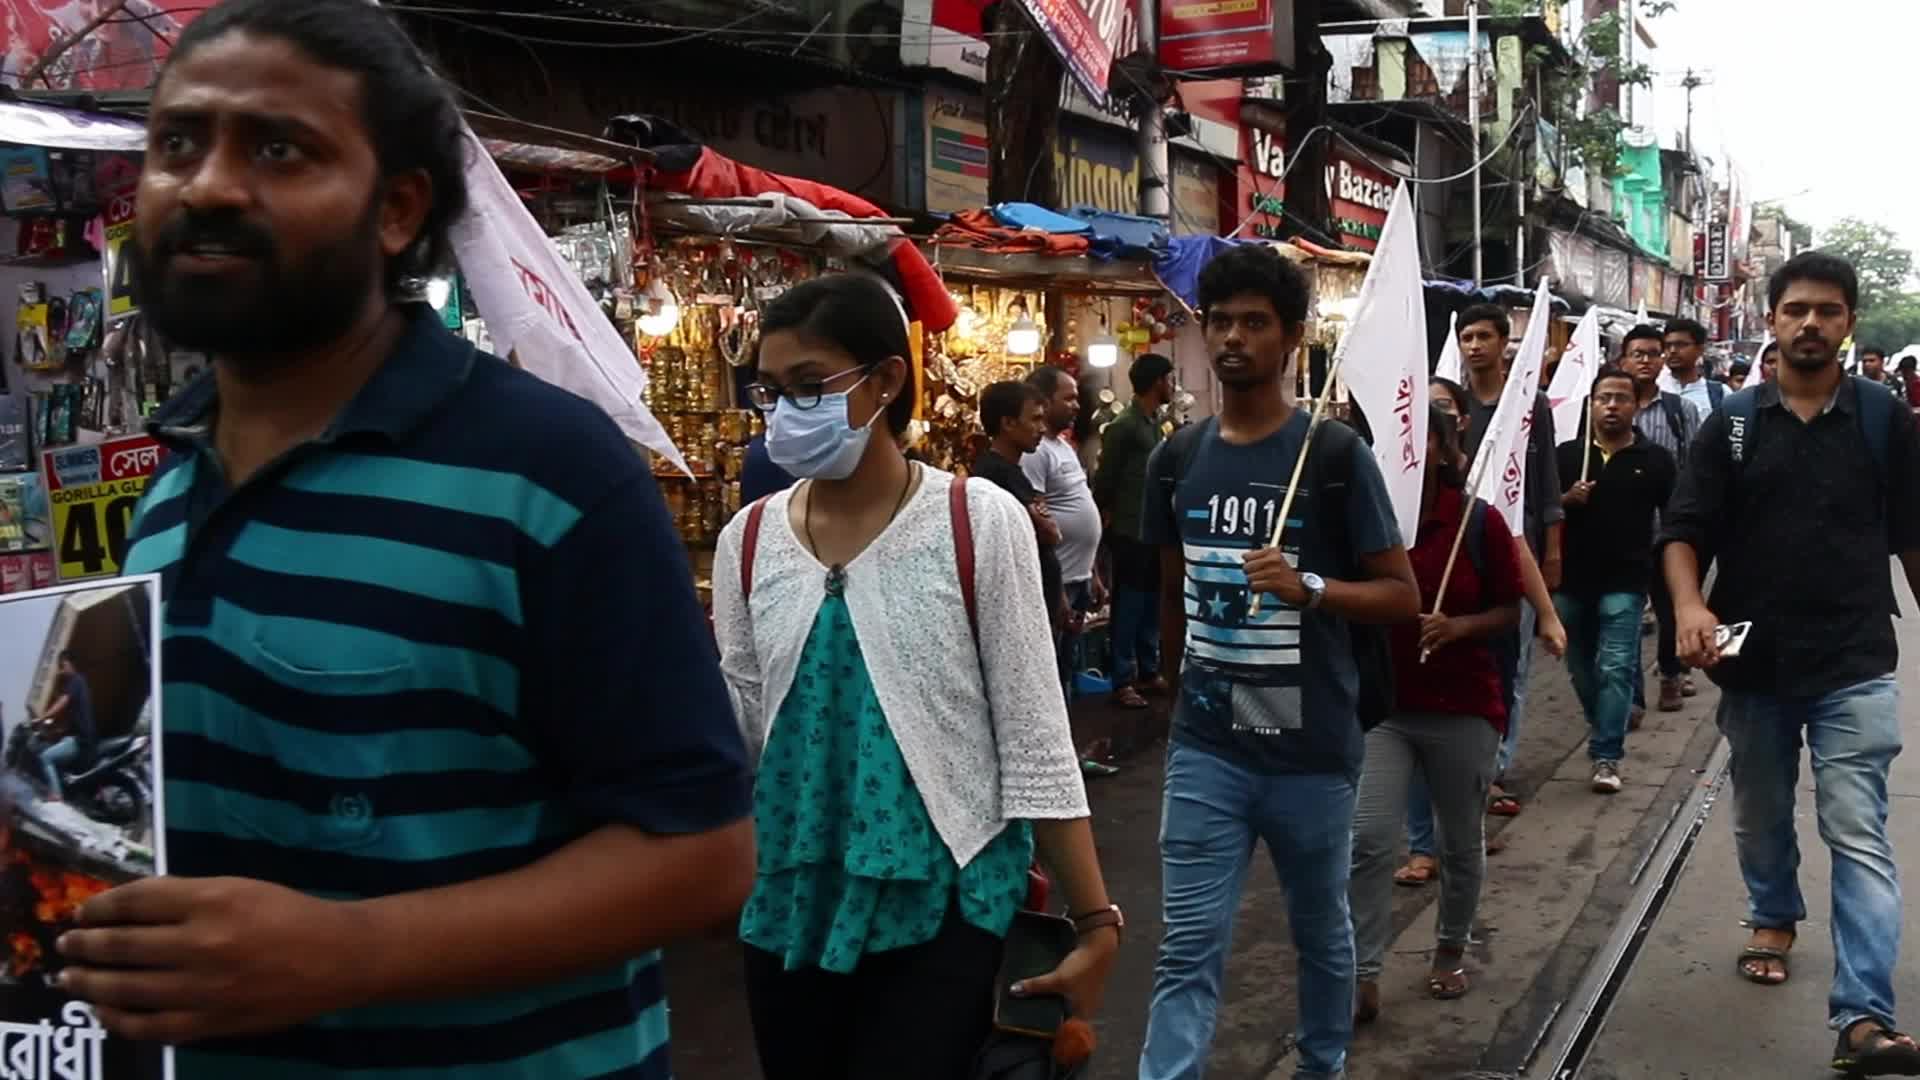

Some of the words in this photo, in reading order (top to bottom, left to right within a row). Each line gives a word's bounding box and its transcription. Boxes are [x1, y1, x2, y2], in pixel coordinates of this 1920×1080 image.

[1339, 160, 1397, 212] Bazaa
[1728, 416, 1746, 461] safari
[110, 446, 160, 476] সেল
[52, 483, 117, 503] GORILLA
[121, 479, 146, 496] GL
